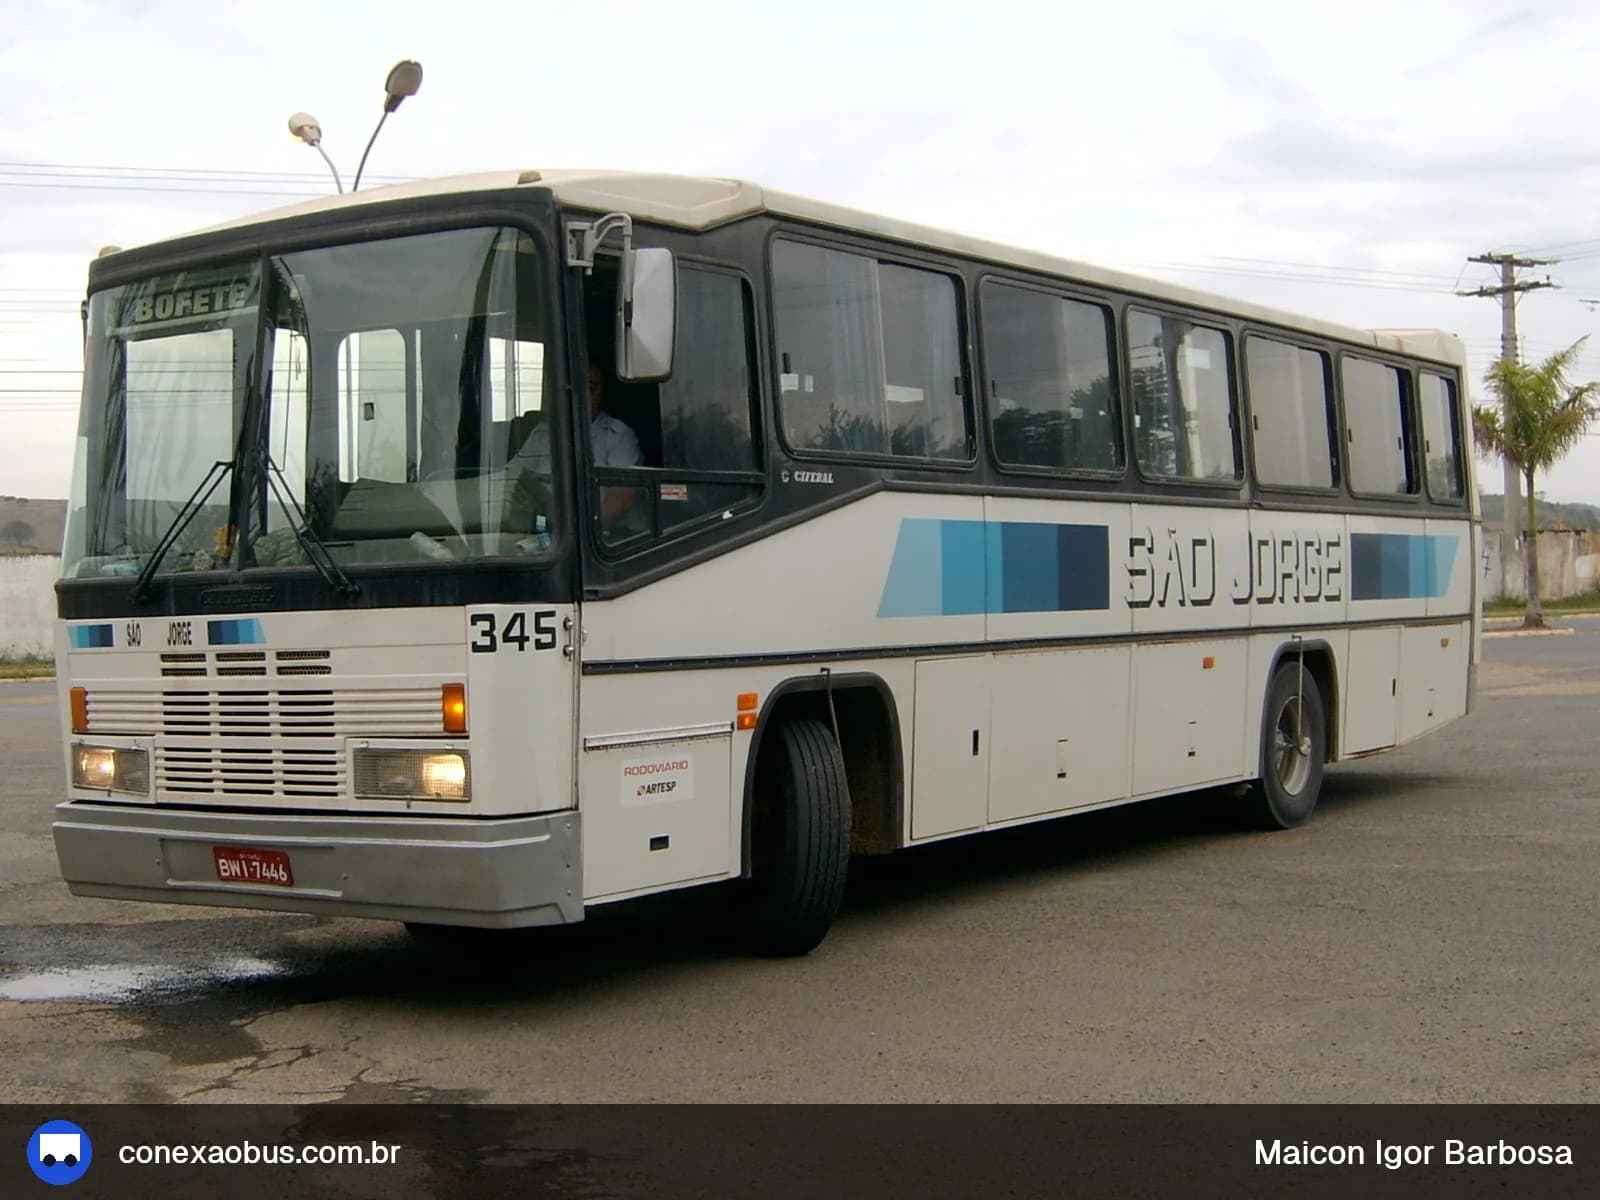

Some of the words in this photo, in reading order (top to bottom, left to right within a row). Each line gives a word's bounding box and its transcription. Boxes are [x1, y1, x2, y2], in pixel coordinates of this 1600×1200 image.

[134, 282, 249, 322] BOFETE
[1124, 524, 1215, 608] SÃO
[1230, 527, 1341, 605] JORGE
[126, 620, 142, 647] SÃO
[167, 621, 192, 646] JORGE
[470, 610, 556, 653] 345
